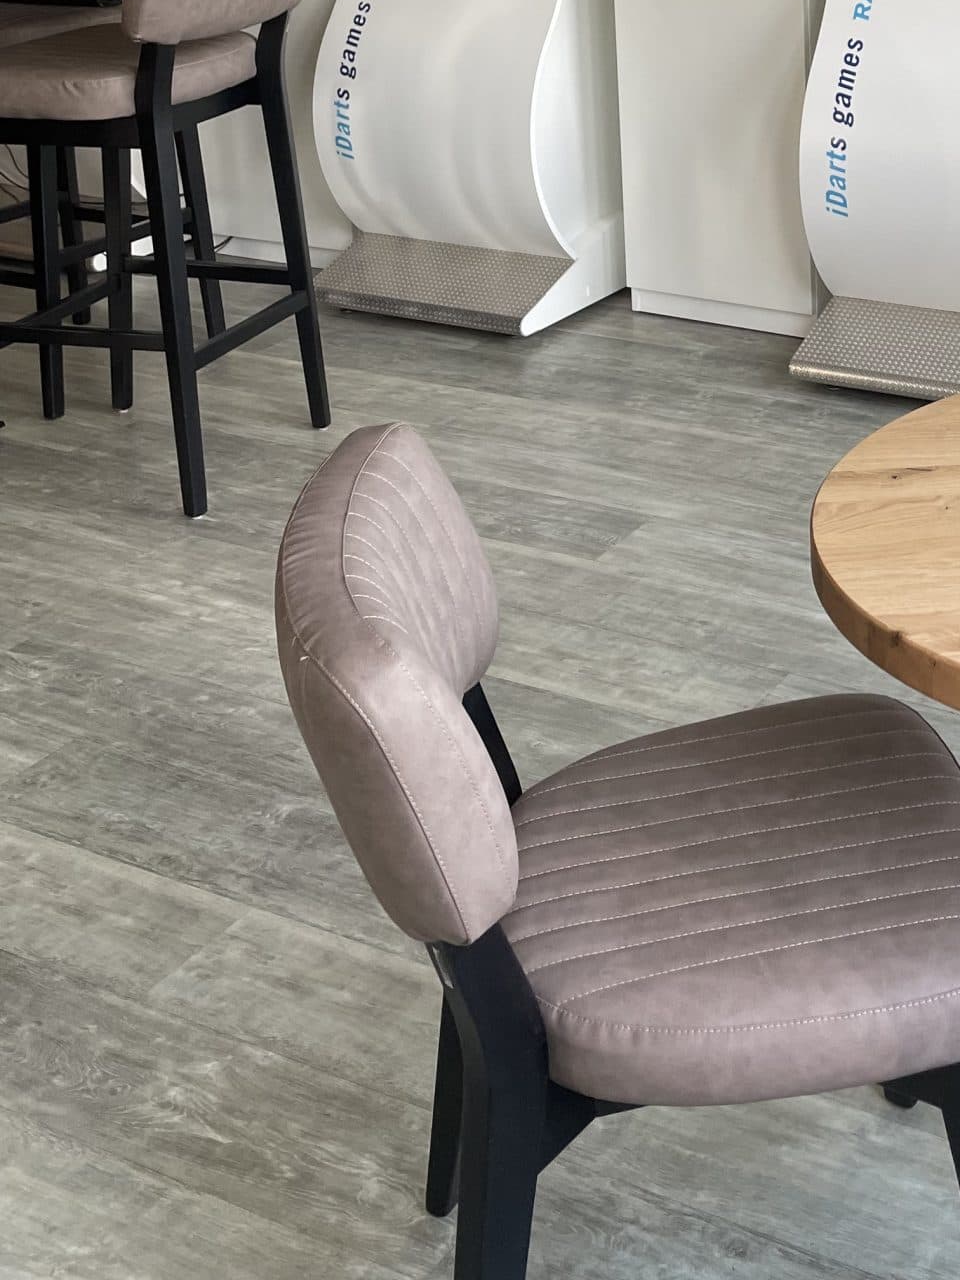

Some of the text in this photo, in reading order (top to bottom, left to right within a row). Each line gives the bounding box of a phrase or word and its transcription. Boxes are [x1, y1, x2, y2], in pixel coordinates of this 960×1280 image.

[339, 1, 372, 81] games
[832, 37, 864, 128] games
[333, 87, 356, 160] iDarts
[825, 136, 849, 218] iDarts
